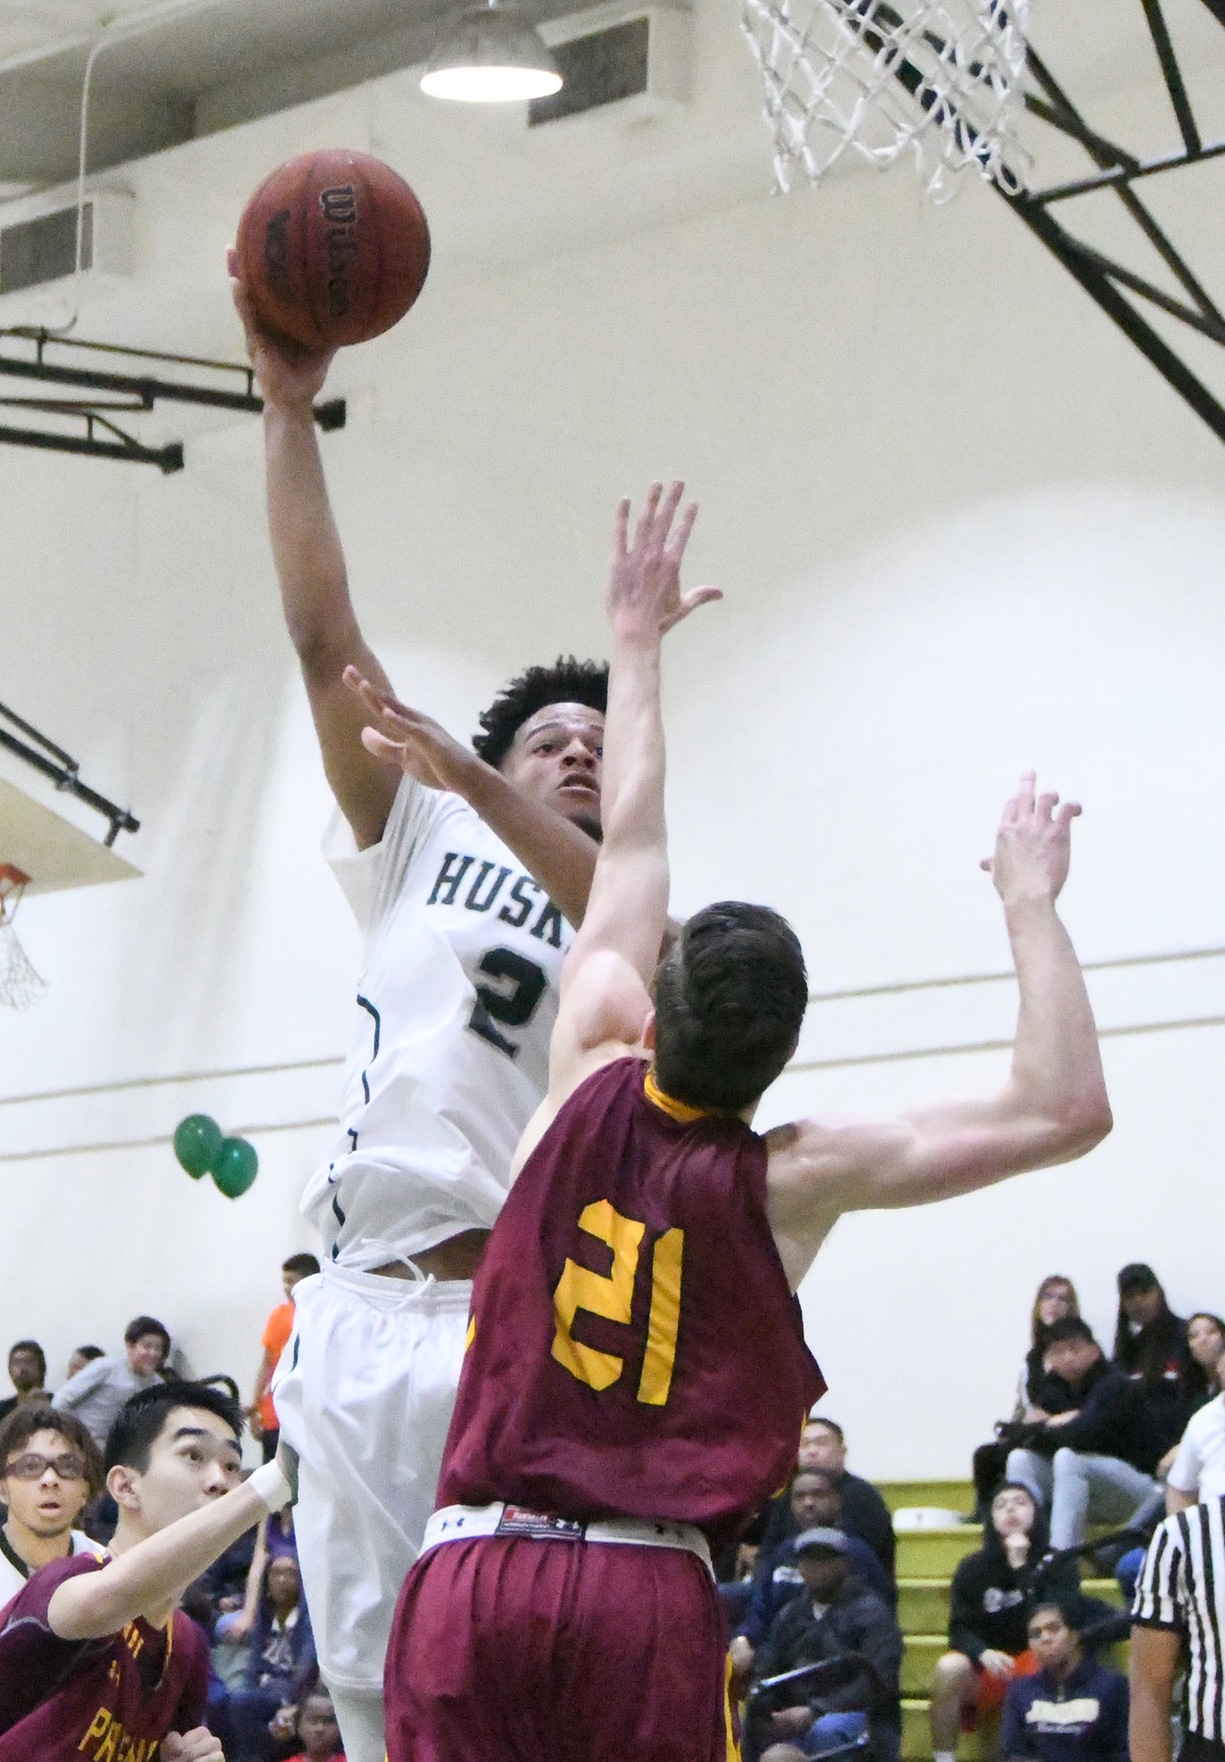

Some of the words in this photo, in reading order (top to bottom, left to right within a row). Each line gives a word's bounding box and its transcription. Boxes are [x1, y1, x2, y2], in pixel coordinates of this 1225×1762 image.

[426, 852, 570, 956] HUSK
[468, 947, 547, 1058] 2
[551, 1198, 685, 1407] 21
